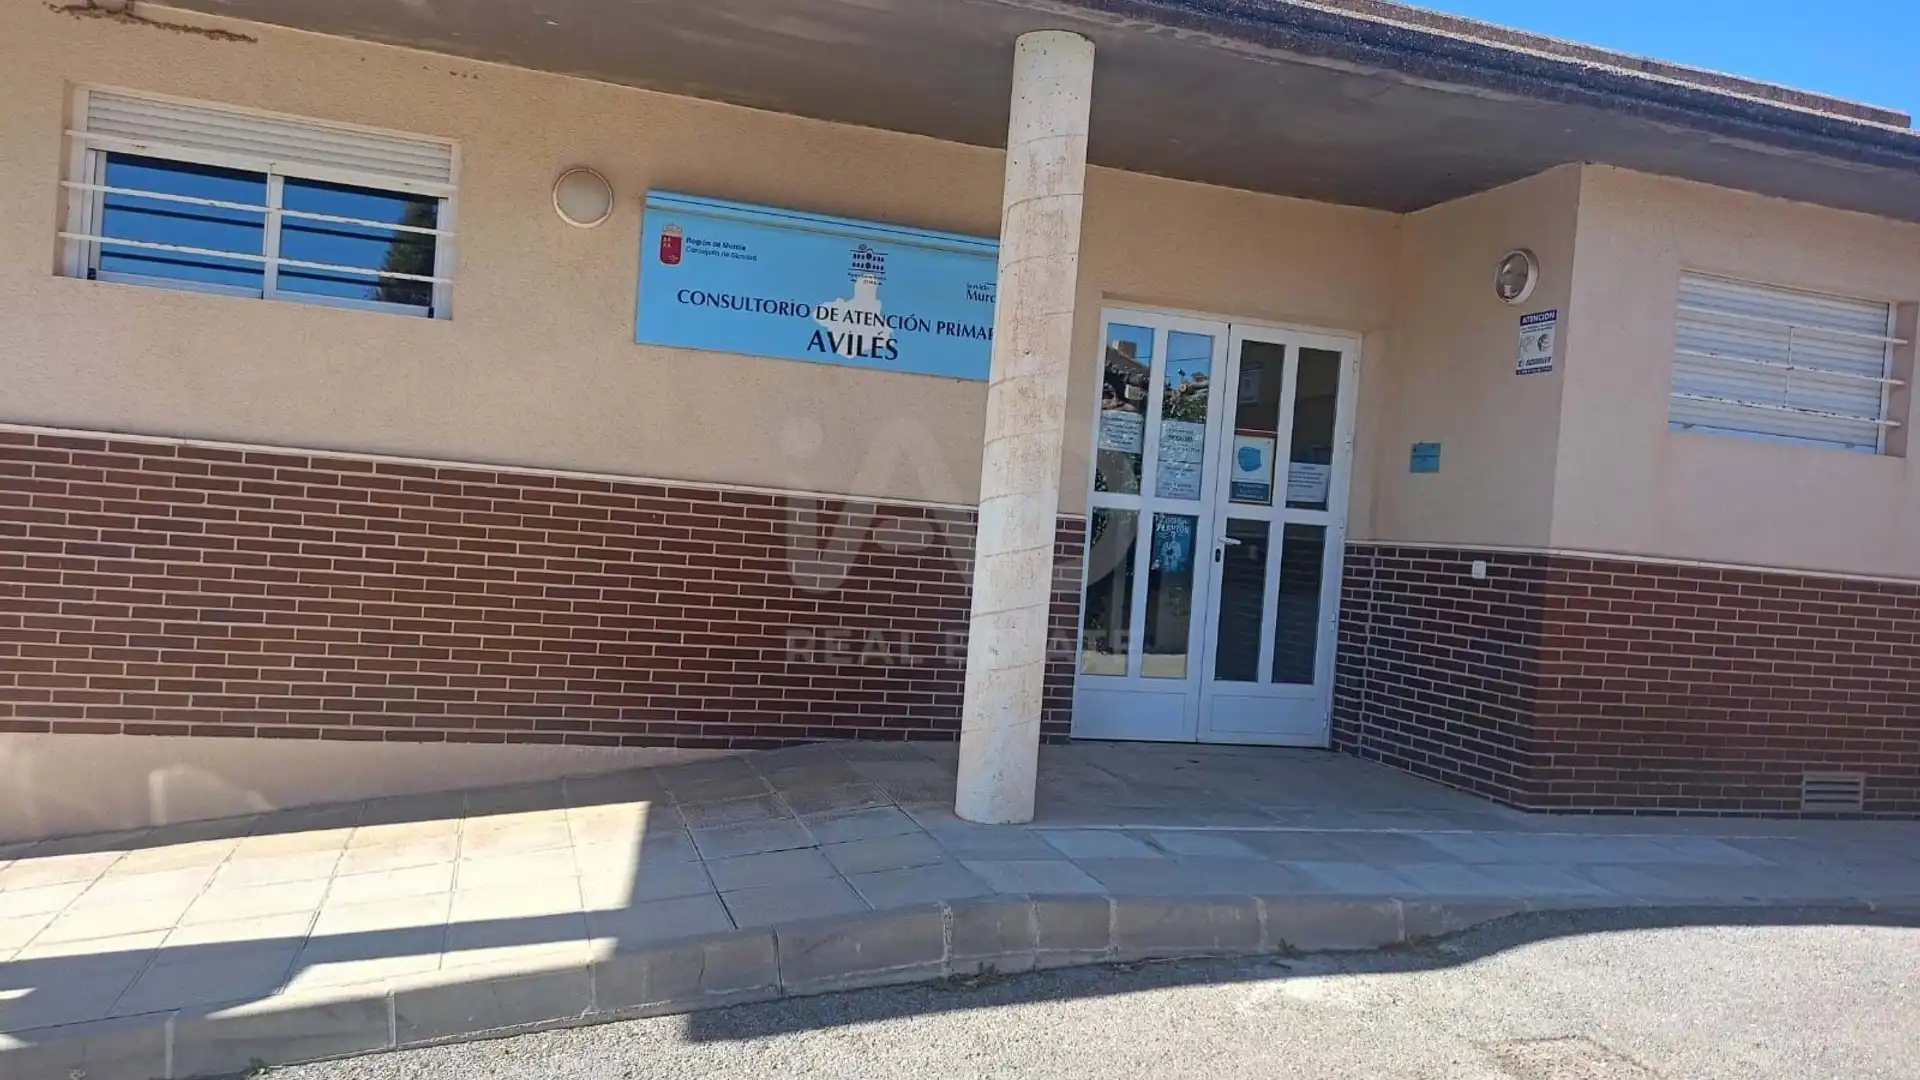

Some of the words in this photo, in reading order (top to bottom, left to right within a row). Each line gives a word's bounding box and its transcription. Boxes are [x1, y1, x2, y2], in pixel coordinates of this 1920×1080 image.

[722, 242, 747, 251] Murcia
[677, 289, 811, 319] CONSULTORIO
[815, 305, 840, 322] DE
[843, 309, 931, 334] ATENCIÓN
[806, 329, 899, 361] AVILÉS
